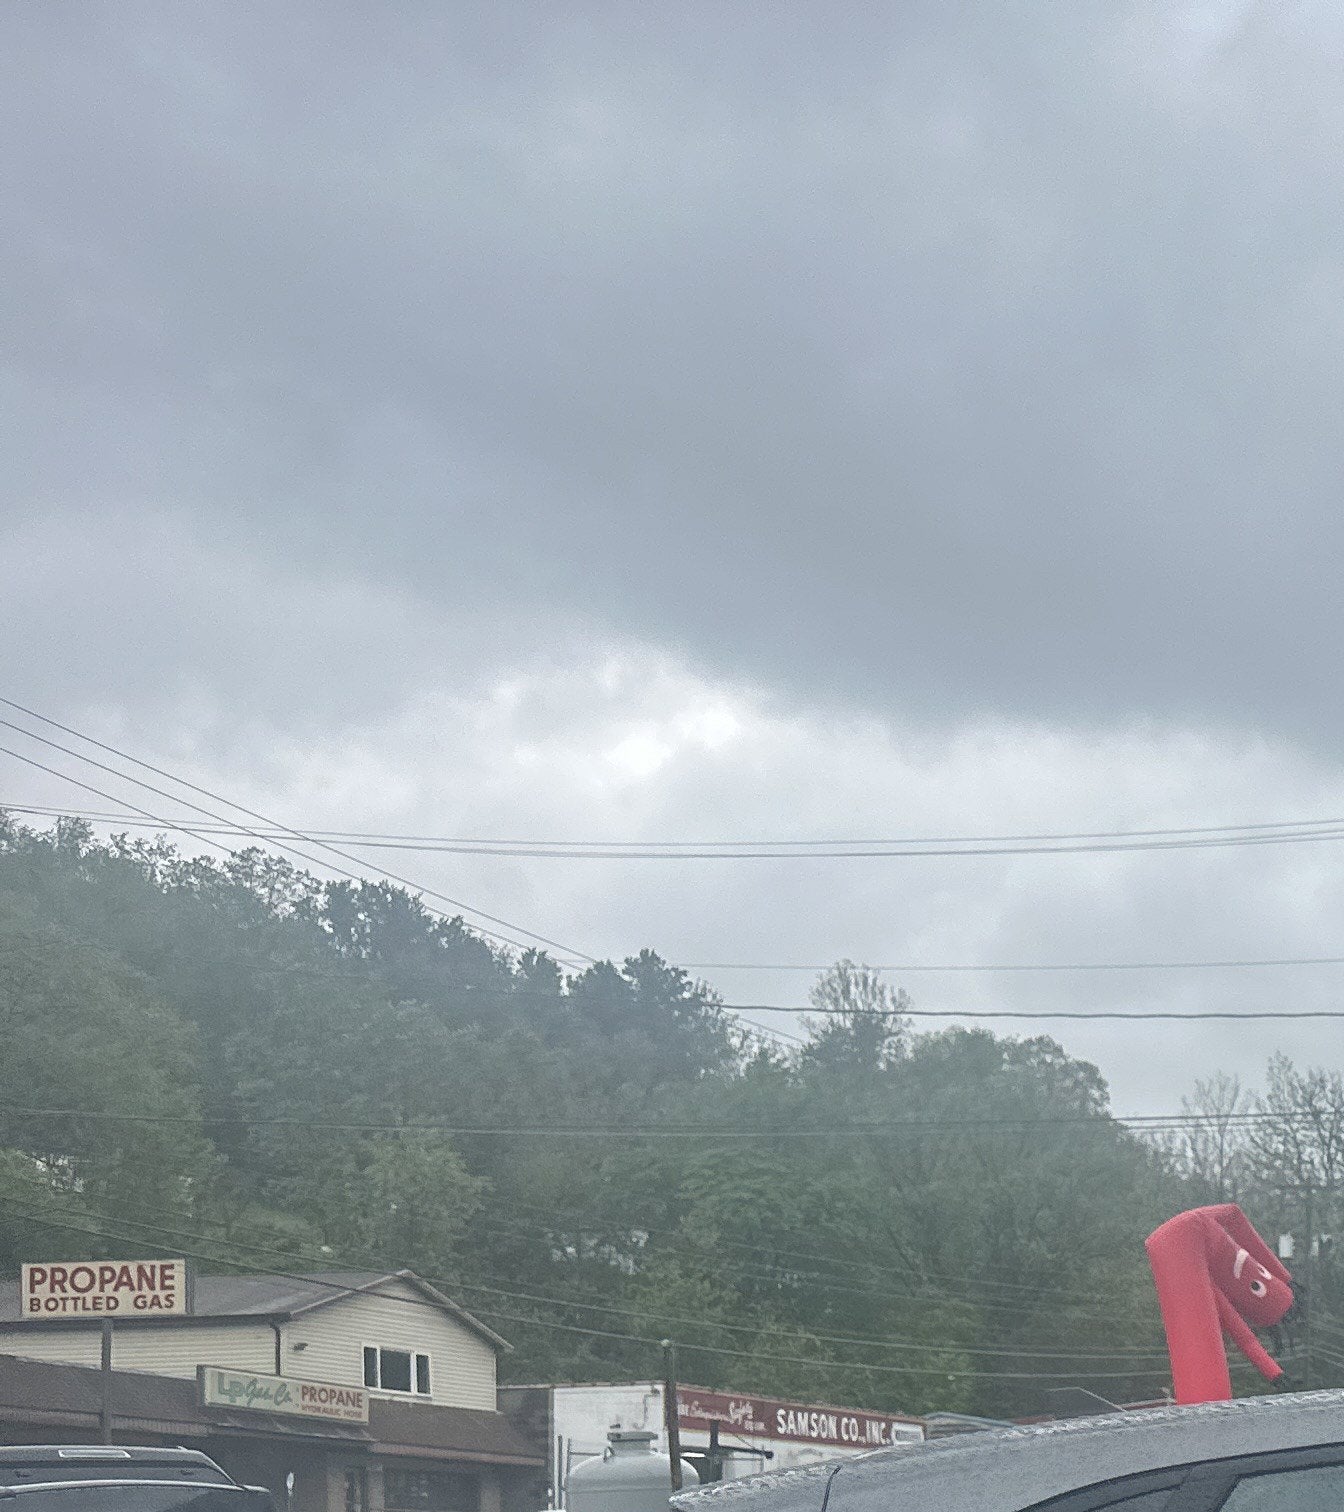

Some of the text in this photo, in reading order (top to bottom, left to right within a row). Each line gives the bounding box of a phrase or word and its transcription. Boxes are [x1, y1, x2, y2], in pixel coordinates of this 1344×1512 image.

[29, 1264, 175, 1293] PROPANE
[29, 1293, 175, 1312] BOTTLED GAS
[301, 1385, 363, 1409] PROPANE
[776, 1408, 838, 1439] SAMSON
[866, 1419, 891, 1445] INC.
